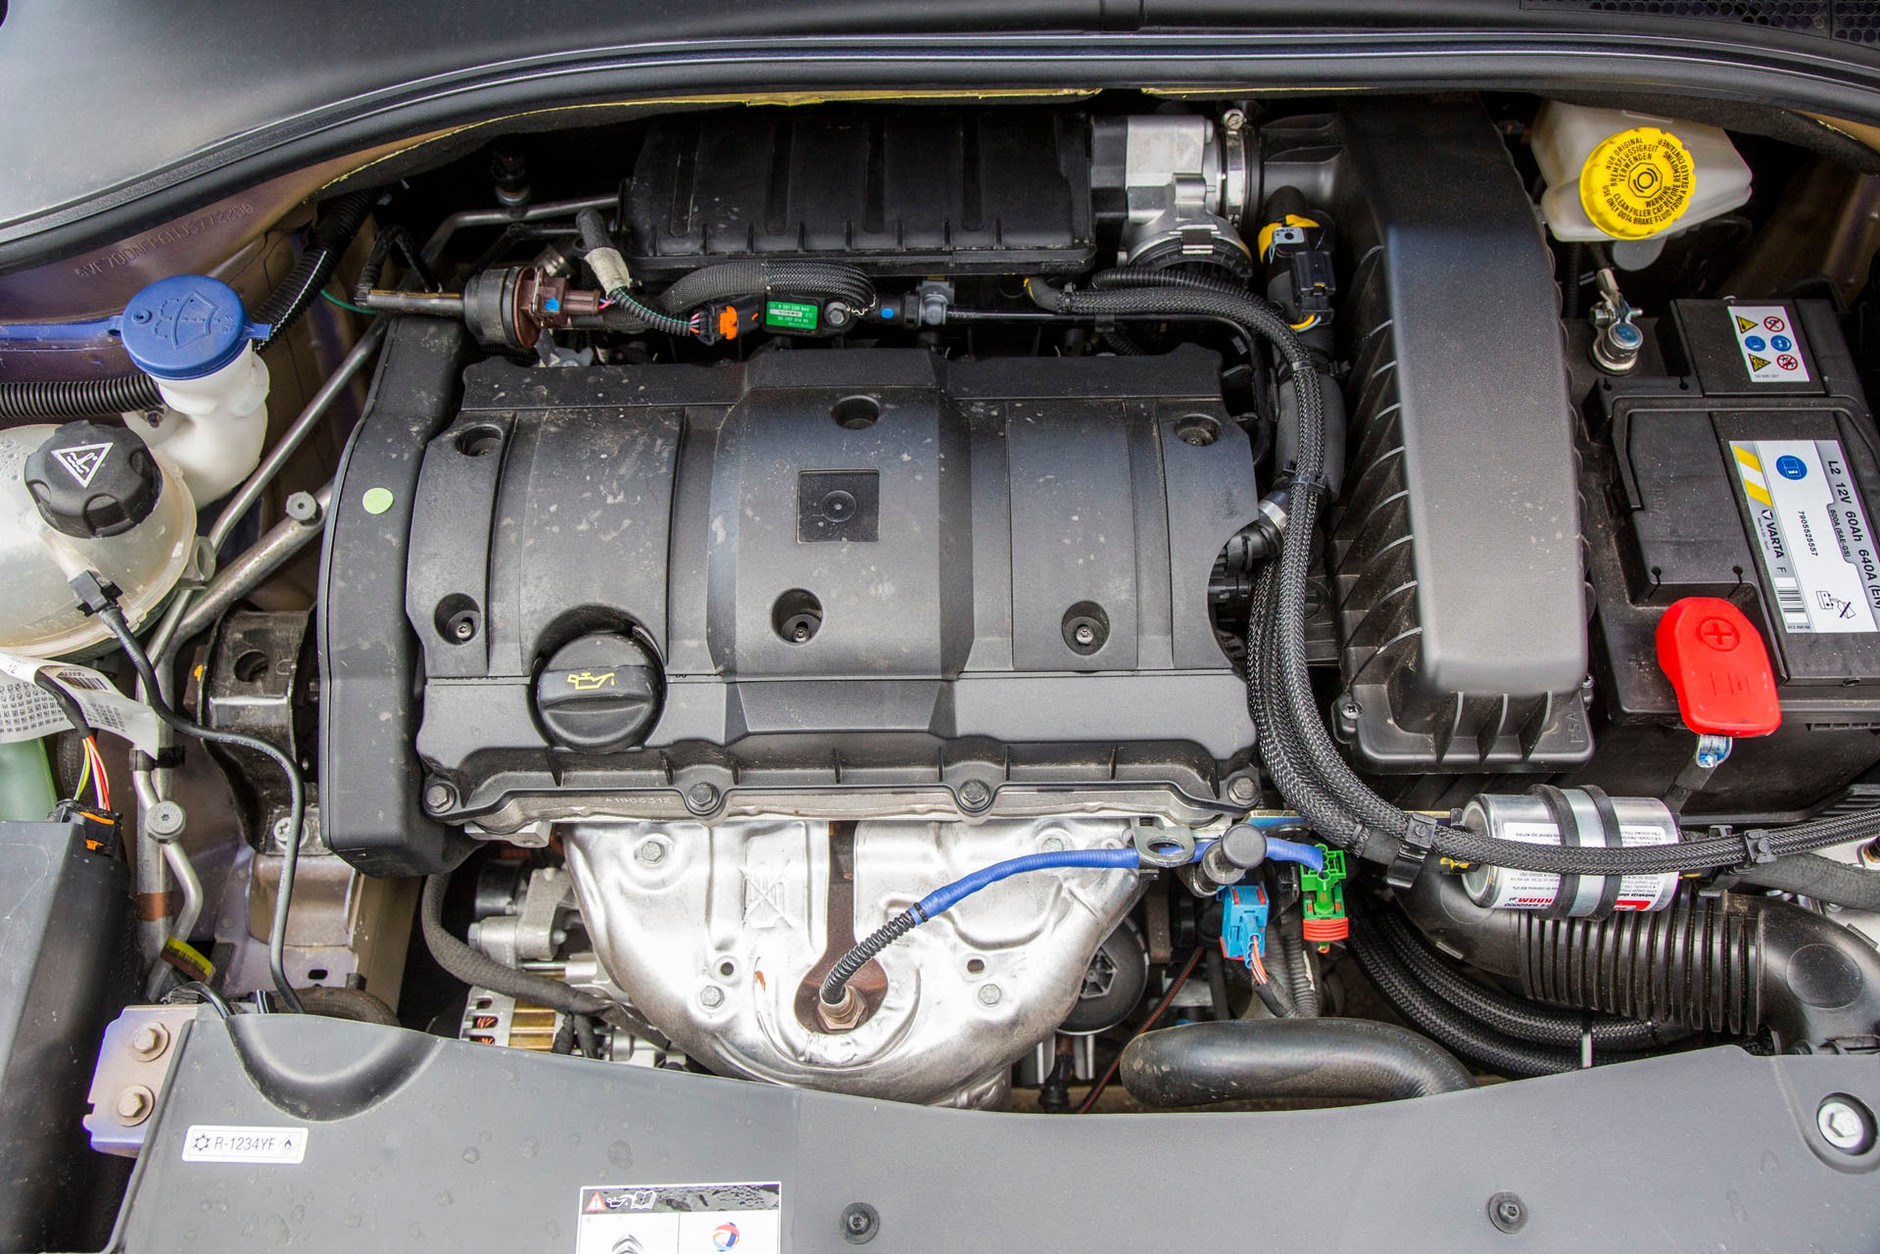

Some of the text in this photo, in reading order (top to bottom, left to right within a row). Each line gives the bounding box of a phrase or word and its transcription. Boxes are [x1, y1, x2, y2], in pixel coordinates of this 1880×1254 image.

[1605, 137, 1644, 170] NUR ORIGINAL
[1657, 139, 1686, 165] CONTAINER
[1619, 153, 1652, 182] VERWENDEN
[1680, 164, 1689, 189] SEALED
[1602, 185, 1611, 197] USE
[1613, 150, 1681, 217] CLEAN FILLER CAP BEFORE REMOVING
[1606, 197, 1619, 212] ONLY
[1645, 185, 1671, 208] WARNING
[1670, 194, 1685, 212] FROM
[1617, 210, 1632, 222] DOT4
[1633, 216, 1653, 225] BRAKE
[1654, 209, 1673, 223] FLUID
[1827, 460, 1841, 475] L2
[1836, 482, 1852, 504] 12V
[1846, 511, 1864, 542] 60Ah
[1859, 549, 1878, 581] 640A
[1830, 509, 1840, 527] 600A
[1765, 522, 1785, 558] VARTA
[1798, 510, 1818, 556] 7905525557
[214, 1136, 277, 1151] R-1234YF
